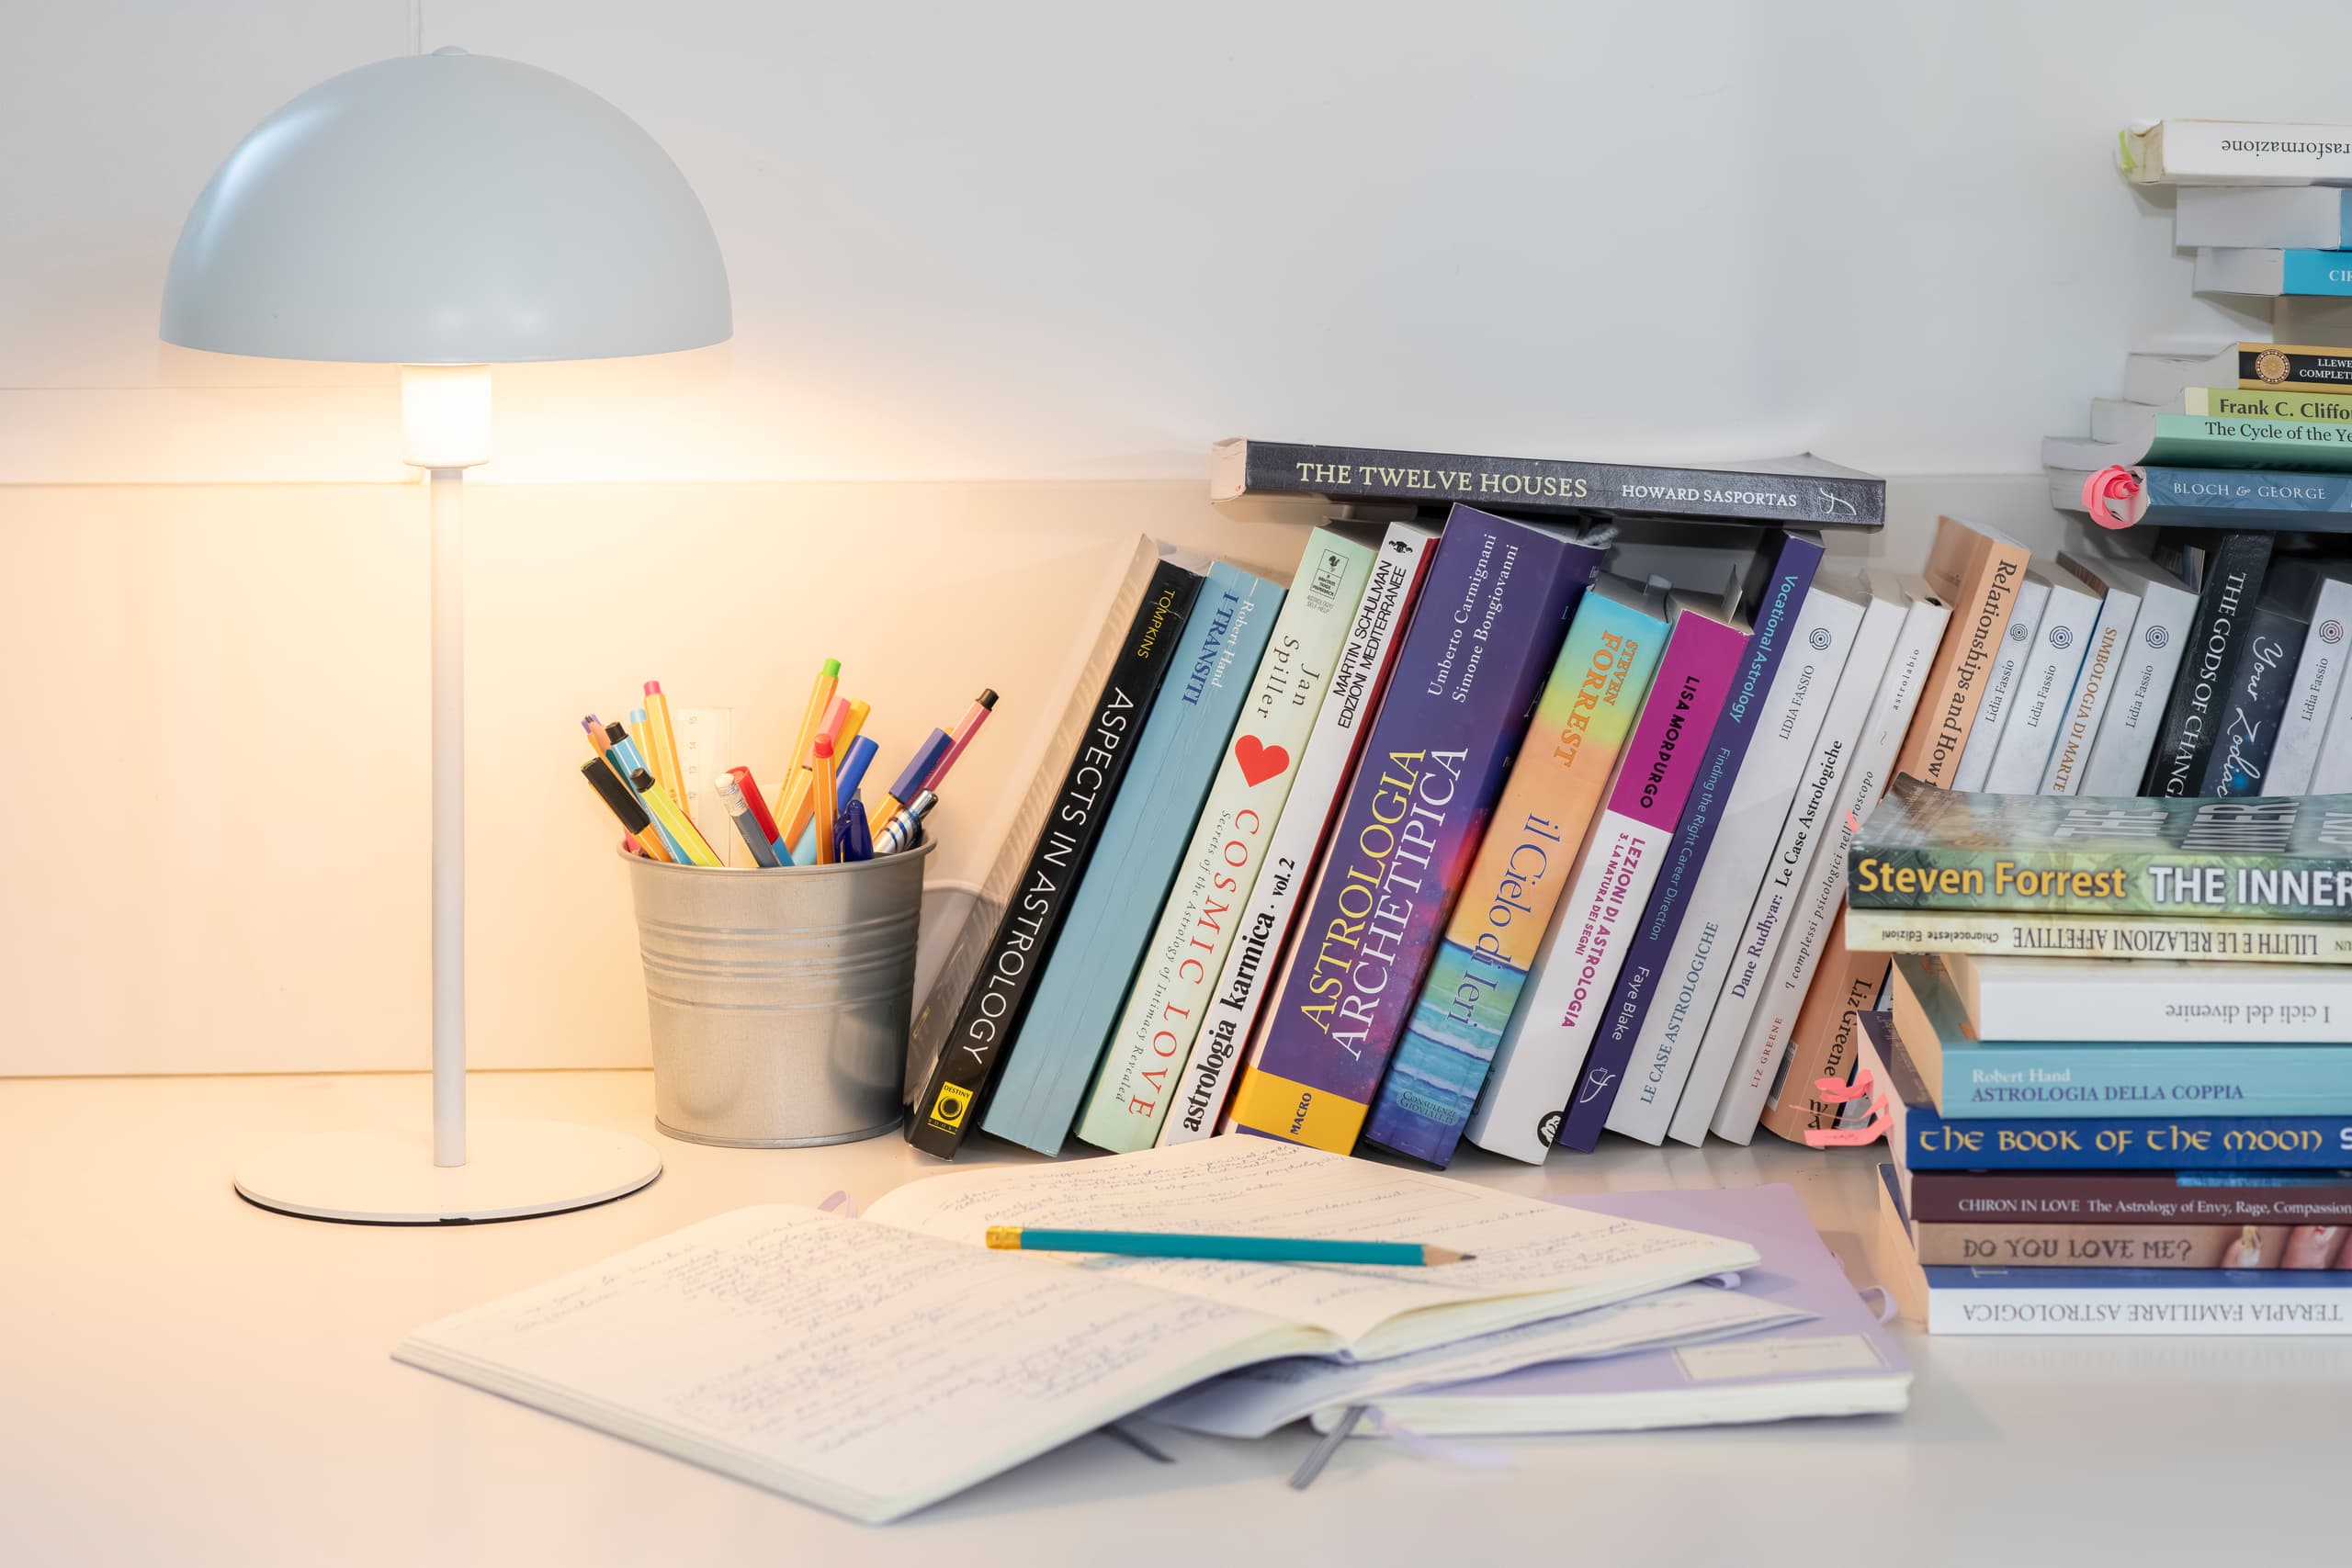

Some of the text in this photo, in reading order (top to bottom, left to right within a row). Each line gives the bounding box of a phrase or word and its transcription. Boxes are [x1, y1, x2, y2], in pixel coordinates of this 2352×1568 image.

[2204, 422, 2332, 442] The Cycle of the
[2220, 399, 2294, 417] Frank C.
[1296, 462, 1798, 507] THE TWELVE HOUSES HOWARD SASPORTAS
[2173, 483, 2326, 501] BLOCH & GEORGE
[1137, 589, 1175, 659] TOMPKINS
[1182, 592, 1239, 706] I TRANSITI
[1211, 599, 1256, 688] Robert Hand
[1333, 559, 1393, 696] MARTIN SCHULMAN
[1338, 566, 1407, 729] EDIZIONI MEDITERRANEE
[1427, 533, 1498, 696] Umberto Carmignani
[1452, 544, 1519, 704] Simone Bongiovanni
[1729, 575, 1799, 724] Vocational Astrology
[1957, 558, 2018, 692] Relationships
[1257, 636, 1300, 718] Spiller
[1292, 663, 1320, 706] Jan
[1553, 629, 1623, 768] FORREST
[1602, 638, 1638, 706] STEVEN
[1779, 664, 1815, 740] LIDIA FASSIO
[1894, 649, 1919, 710] astrolabio
[1985, 660, 2015, 723] Lidia Fassio
[2027, 664, 2056, 728] Lidia Fassio
[2053, 626, 2118, 794] SIMBOLOGIA DI MARTE
[2125, 664, 2154, 728] Lidia Fassio
[2165, 572, 2248, 798] THE GODS OF CHANG
[2301, 657, 2329, 722] Lidia Fassio
[1640, 675, 1700, 808] LISA MORPURGO
[1943, 692, 1966, 734] and
[2216, 636, 2284, 799] Your Zodiac
[1928, 731, 1954, 777] How
[963, 687, 1134, 1065] ASPECTS IN ASTROLOGY
[1650, 747, 1731, 941] Finding the Right Career Direction
[1732, 739, 1843, 999] Dane Rudhyar: Le Case Astrologiche
[1857, 857, 2352, 907] Steven Forrest THE INNER
[1300, 749, 1427, 1034] ASTROLOGIA
[1331, 748, 1469, 1062] ARCHETIPICA
[1447, 811, 1561, 1028] il Cielo di Ieri
[1575, 832, 1629, 956] 3. LA NATURA DEI SEGNI
[1793, 852, 1842, 981] complessi psicologici
[1115, 810, 1231, 1102] Secrets of the Astrology of Intimacy Revealed
[1128, 809, 1260, 1118] COSMIC LOVE
[1561, 837, 1645, 1028] LEZIONI DI ASTROLOGIA
[1881, 926, 2318, 955] LILITH E LE RELAZIONI AFFETTIVE Chiaraceleste Edizioni
[1183, 857, 1295, 1132] astrologia karmica vol. 2
[1611, 965, 1650, 1042] Faye Blake
[1640, 920, 1720, 1105] LE CASE ASTROLOGICHE
[1824, 977, 1873, 1077] Liz Greene
[2165, 1003, 2240, 1022] divenire
[2245, 1004, 2278, 1024] del
[2285, 1004, 2318, 1023] cicli
[1750, 1017, 1783, 1089] LIZ GREENE
[1972, 1068, 2071, 1084] Robert Hand
[944, 1085, 970, 1098] DESTINY
[1289, 1092, 1313, 1136] MACRO
[1971, 1084, 2245, 1103] ASTROLOGIA DELLA COPPIA
[1997, 1130, 2084, 1153] BOOK
[2096, 1130, 2133, 1156] OF
[1958, 1199, 2352, 1218] CHIRON IN LOVE The Astrology of Envy, Rage, Compassion
[1962, 1239, 2193, 1261] DO YOU LOVE ME?
[1962, 1303, 2343, 1324] TERAPIA FAMILIARE ASTROLOGICA
